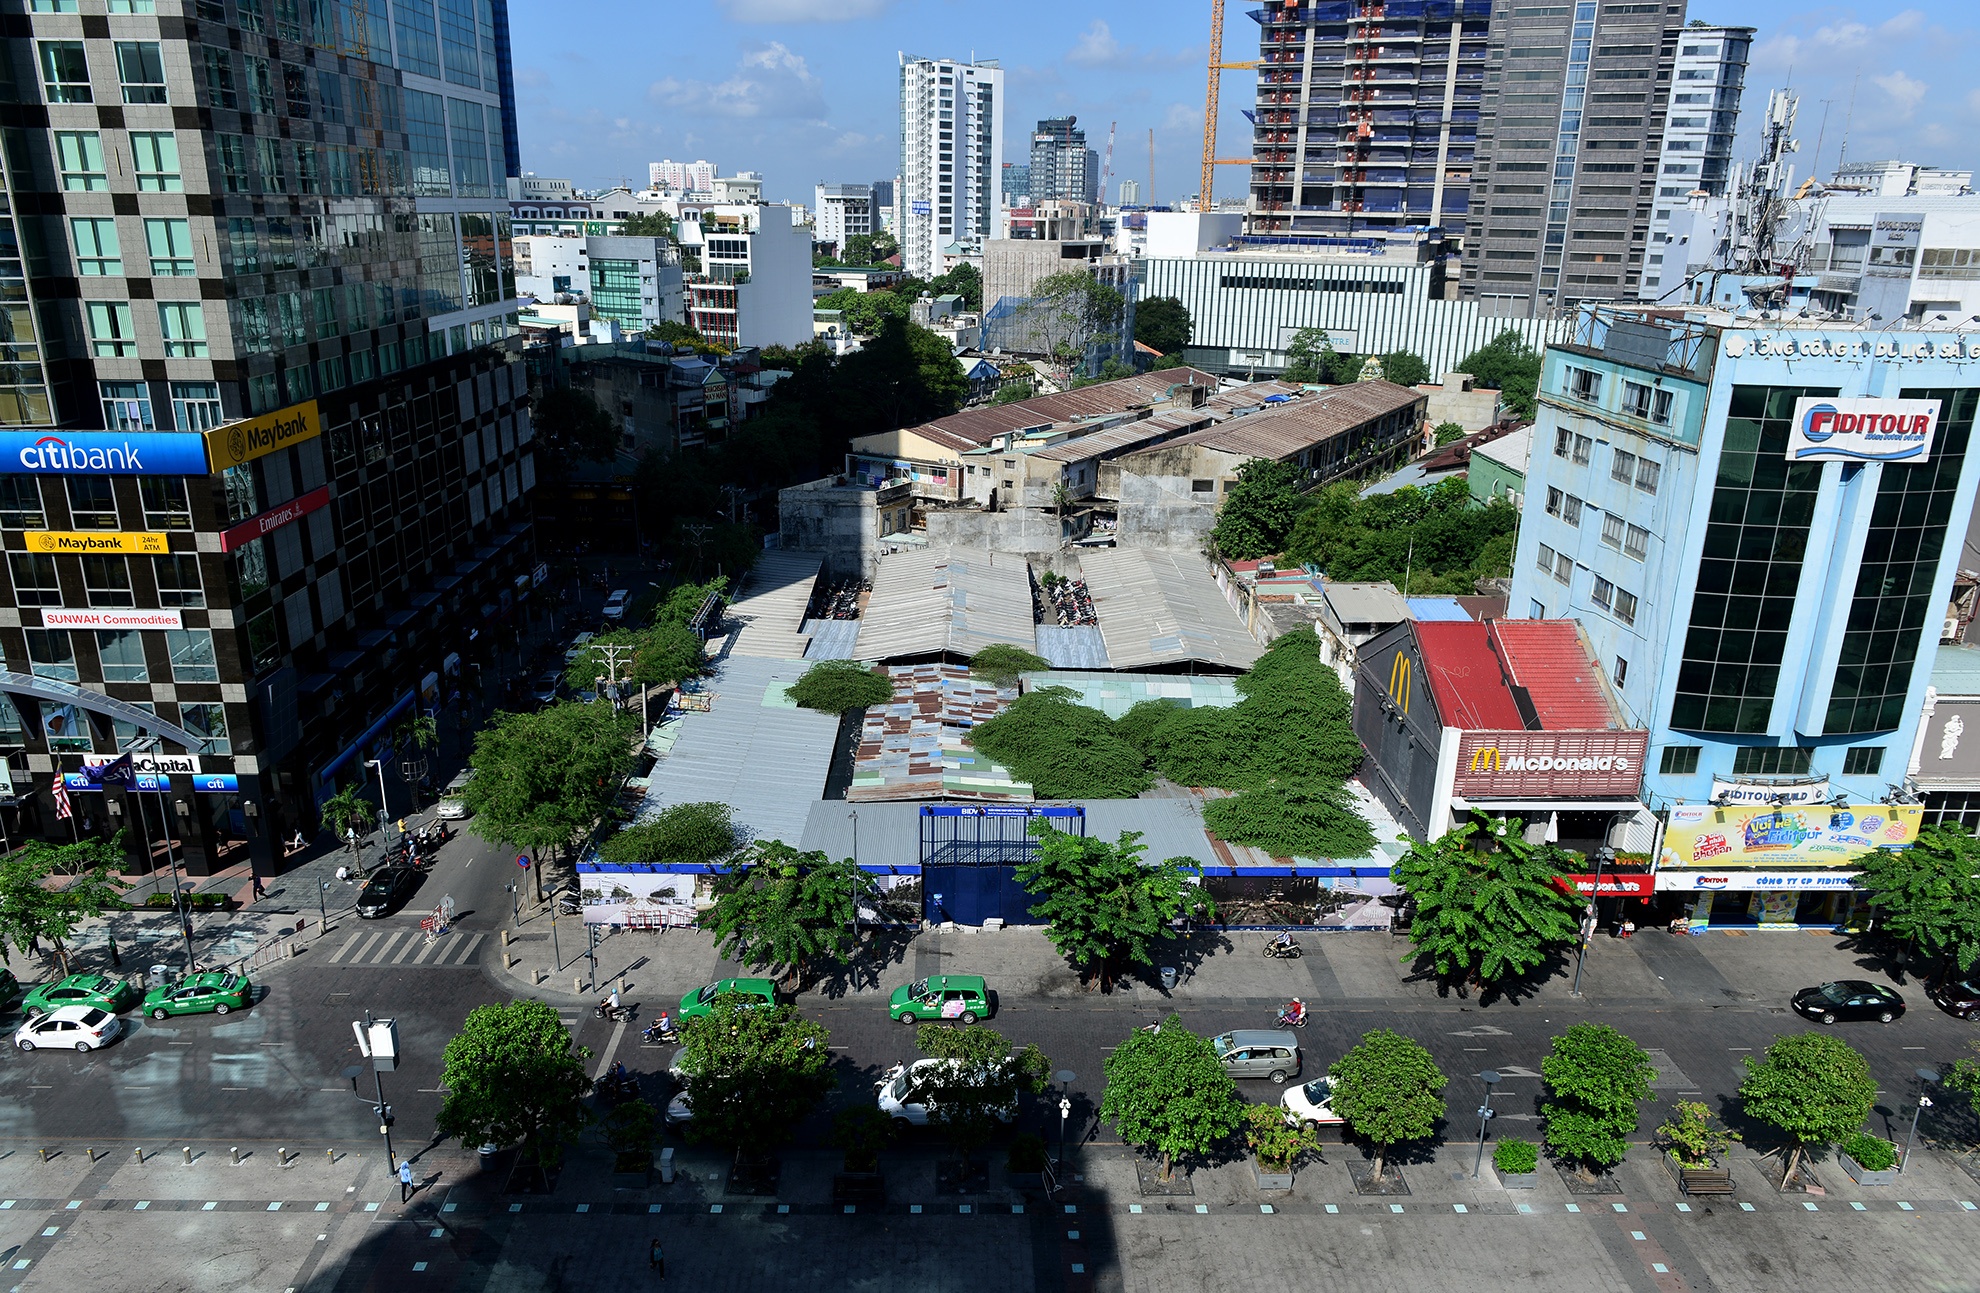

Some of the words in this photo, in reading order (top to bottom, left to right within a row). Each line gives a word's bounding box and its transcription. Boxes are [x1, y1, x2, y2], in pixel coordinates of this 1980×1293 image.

[1799, 337, 1848, 357] CÔNG
[1809, 411, 1930, 435] FIDITOUR
[247, 411, 308, 452] Maybank
[19, 440, 143, 469] citibank
[259, 508, 293, 533] Emirates
[58, 536, 123, 551] Maybank
[47, 614, 100, 624] SUNWAH
[103, 614, 179, 625] Commodities
[104, 758, 195, 774] aCapital
[1505, 755, 1629, 771] McDonald's
[138, 778, 157, 789] citi
[207, 779, 225, 789] citi
[1768, 829, 1823, 842] Fiditour
[1577, 881, 1640, 892] McDonald's
[1801, 877, 1813, 885] CP
